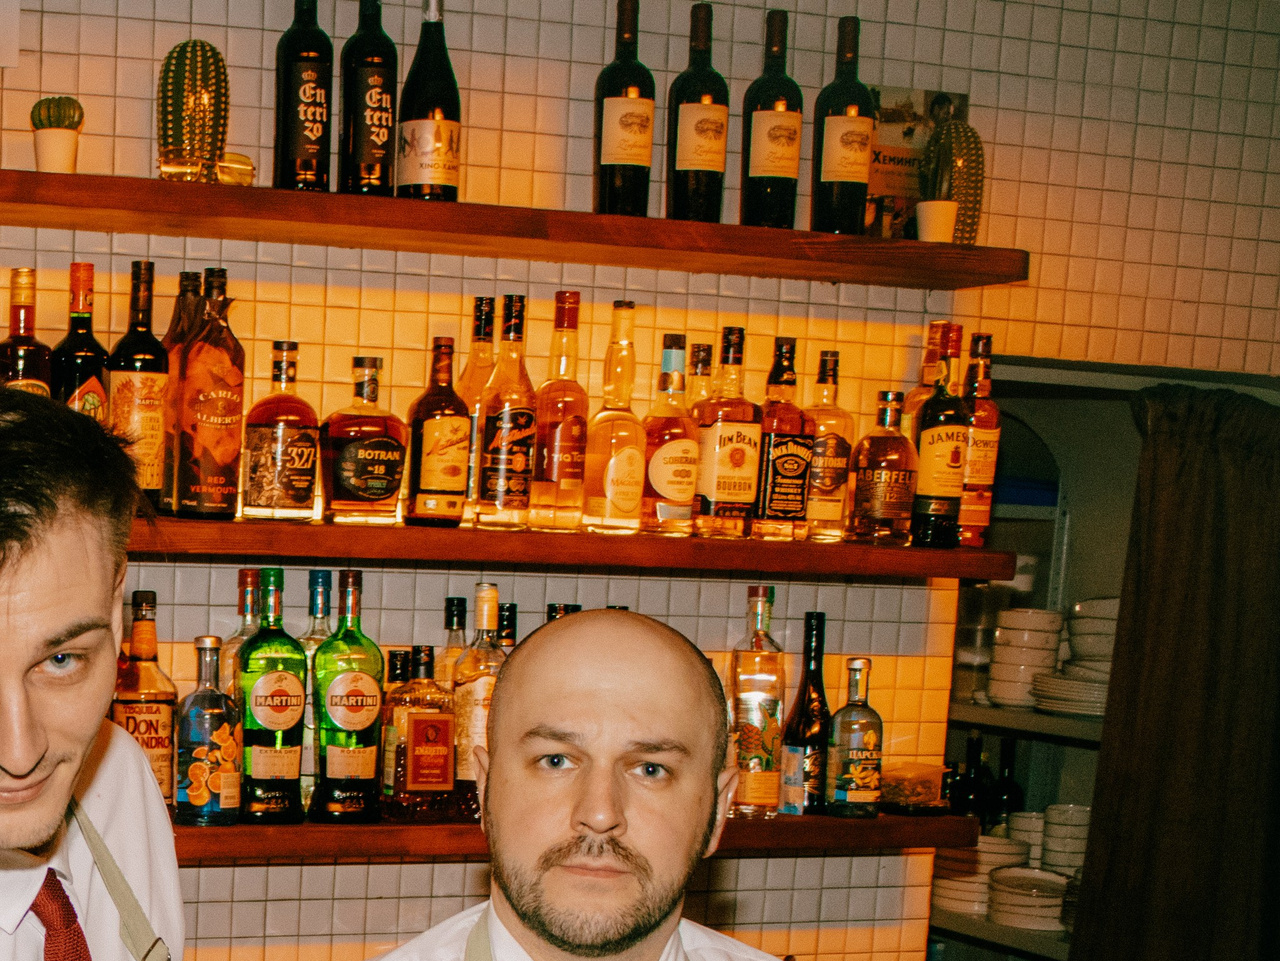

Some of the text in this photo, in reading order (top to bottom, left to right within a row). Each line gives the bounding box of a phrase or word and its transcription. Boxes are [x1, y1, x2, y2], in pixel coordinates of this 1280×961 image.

[298, 82, 326, 104] En
[365, 88, 391, 109] En
[198, 390, 240, 402] CARLO
[714, 434, 734, 452] JIM
[928, 432, 969, 446] JAMES
[287, 447, 315, 469] 327
[357, 449, 400, 460] BOTRAN
[662, 456, 697, 465] SOBERAN
[207, 476, 226, 484] RED
[858, 469, 911, 483] ABERFEL
[190, 485, 237, 494] VERMOUTH
[716, 480, 753, 492] BOURBON
[256, 696, 300, 706] MARTINI
[331, 696, 377, 706] MARTINI
[123, 705, 161, 715] TEQUILA
[126, 716, 159, 735] DON
[849, 750, 881, 759] ЦАРСК
